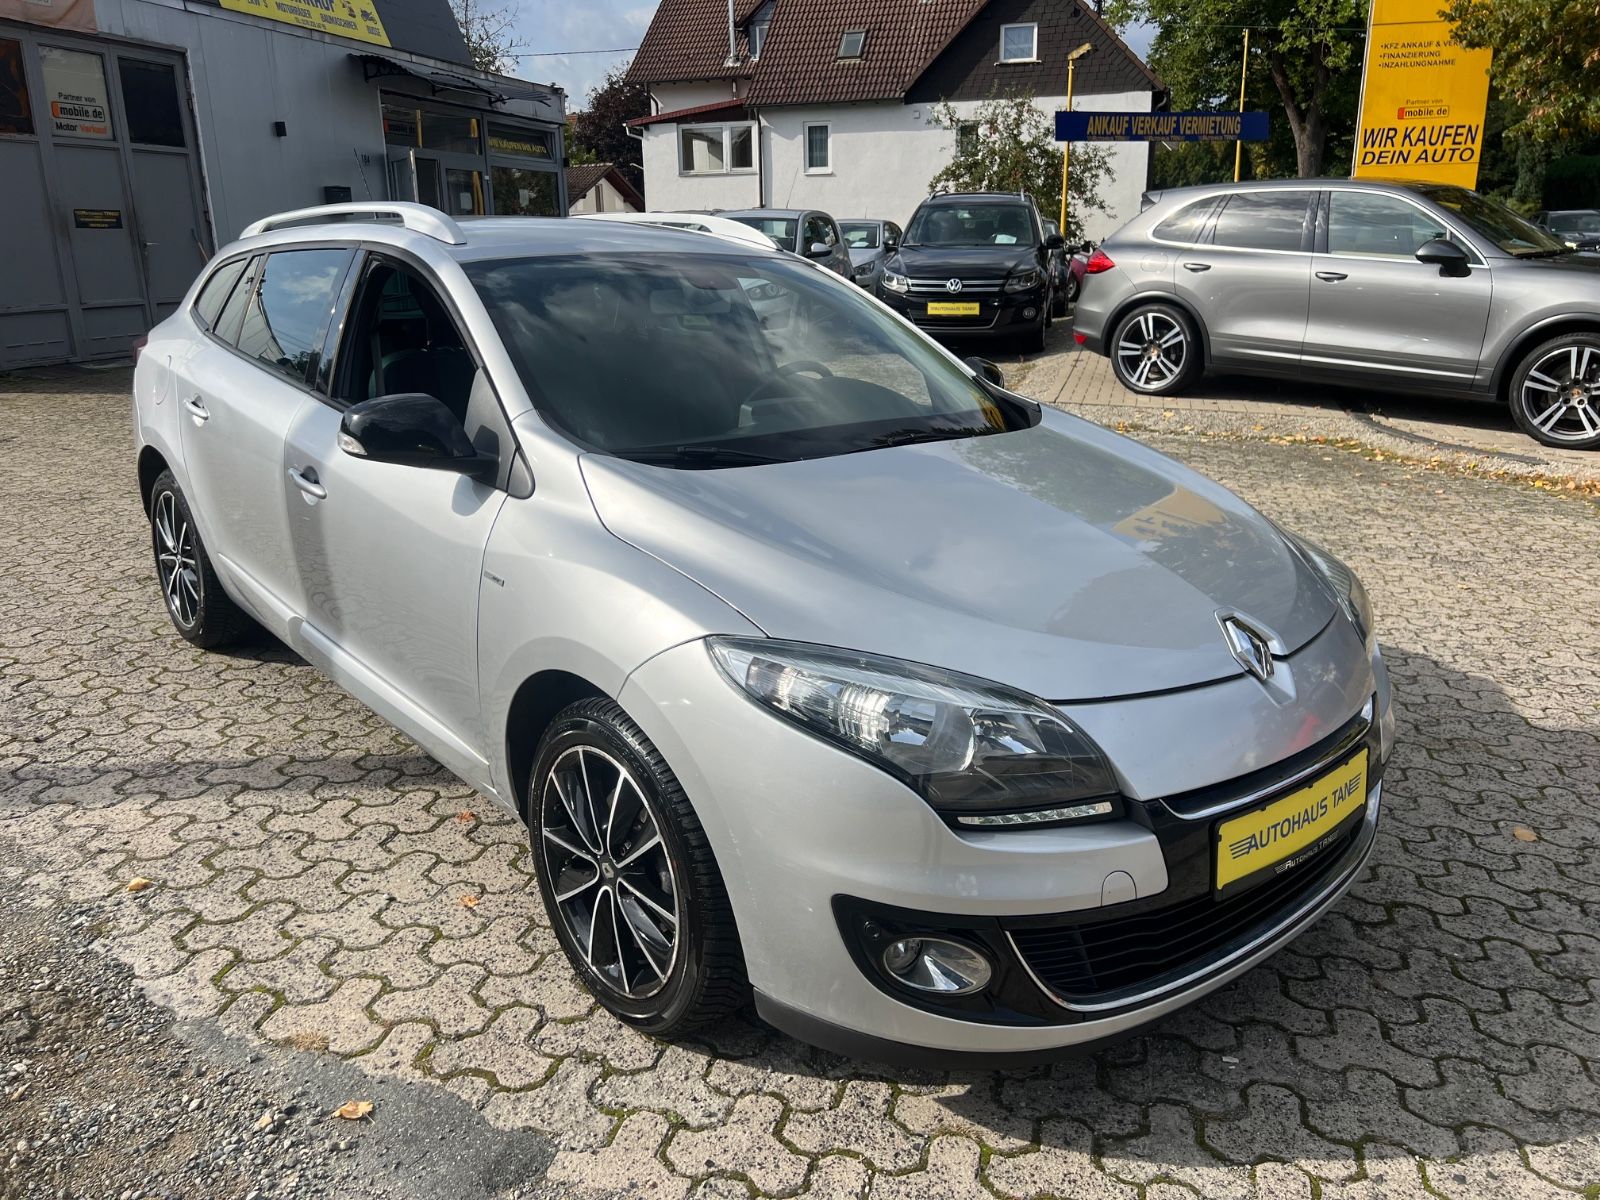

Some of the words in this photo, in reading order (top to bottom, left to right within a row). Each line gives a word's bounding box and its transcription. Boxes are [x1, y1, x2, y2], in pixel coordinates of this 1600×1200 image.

[1401, 40, 1433, 49] ANKAUF
[55, 121, 78, 132] Motor
[1087, 116, 1129, 135] ANKAUF
[1131, 116, 1177, 135] VERKAUF
[1179, 116, 1241, 135] VERMIETUNG
[1363, 127, 1398, 149] WIR
[1401, 124, 1479, 147] KAUFEN
[1361, 150, 1411, 166] DEIN
[1414, 147, 1475, 164] AUTO
[1246, 796, 1328, 854] AUTOHAUS
[1332, 779, 1351, 808] TAN
